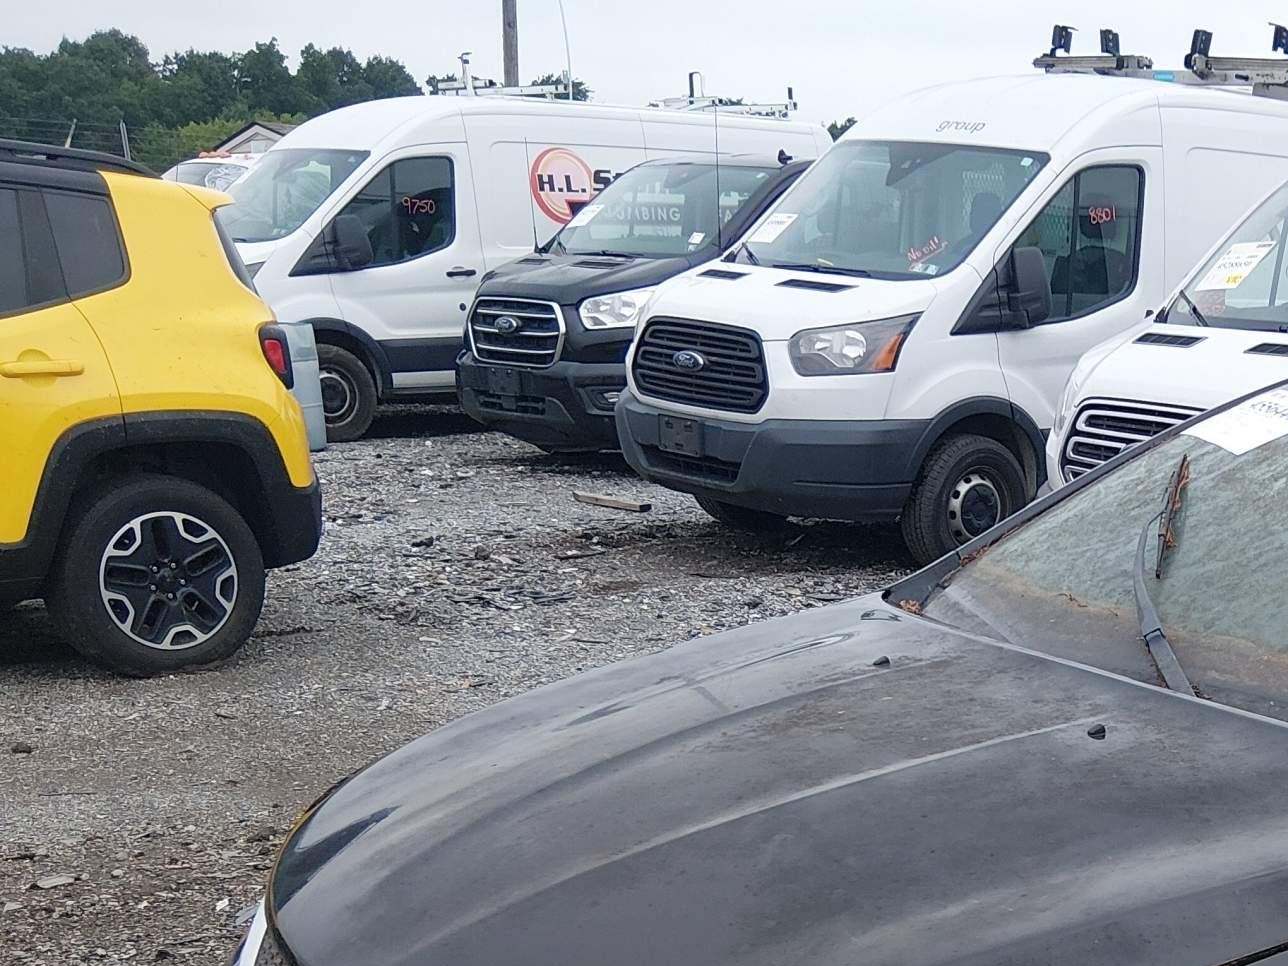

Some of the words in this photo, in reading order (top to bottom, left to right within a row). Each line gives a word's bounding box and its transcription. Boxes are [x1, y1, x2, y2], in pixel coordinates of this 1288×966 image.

[935, 120, 986, 134] group
[402, 196, 436, 215] 9750
[1088, 206, 1116, 225] 8801
